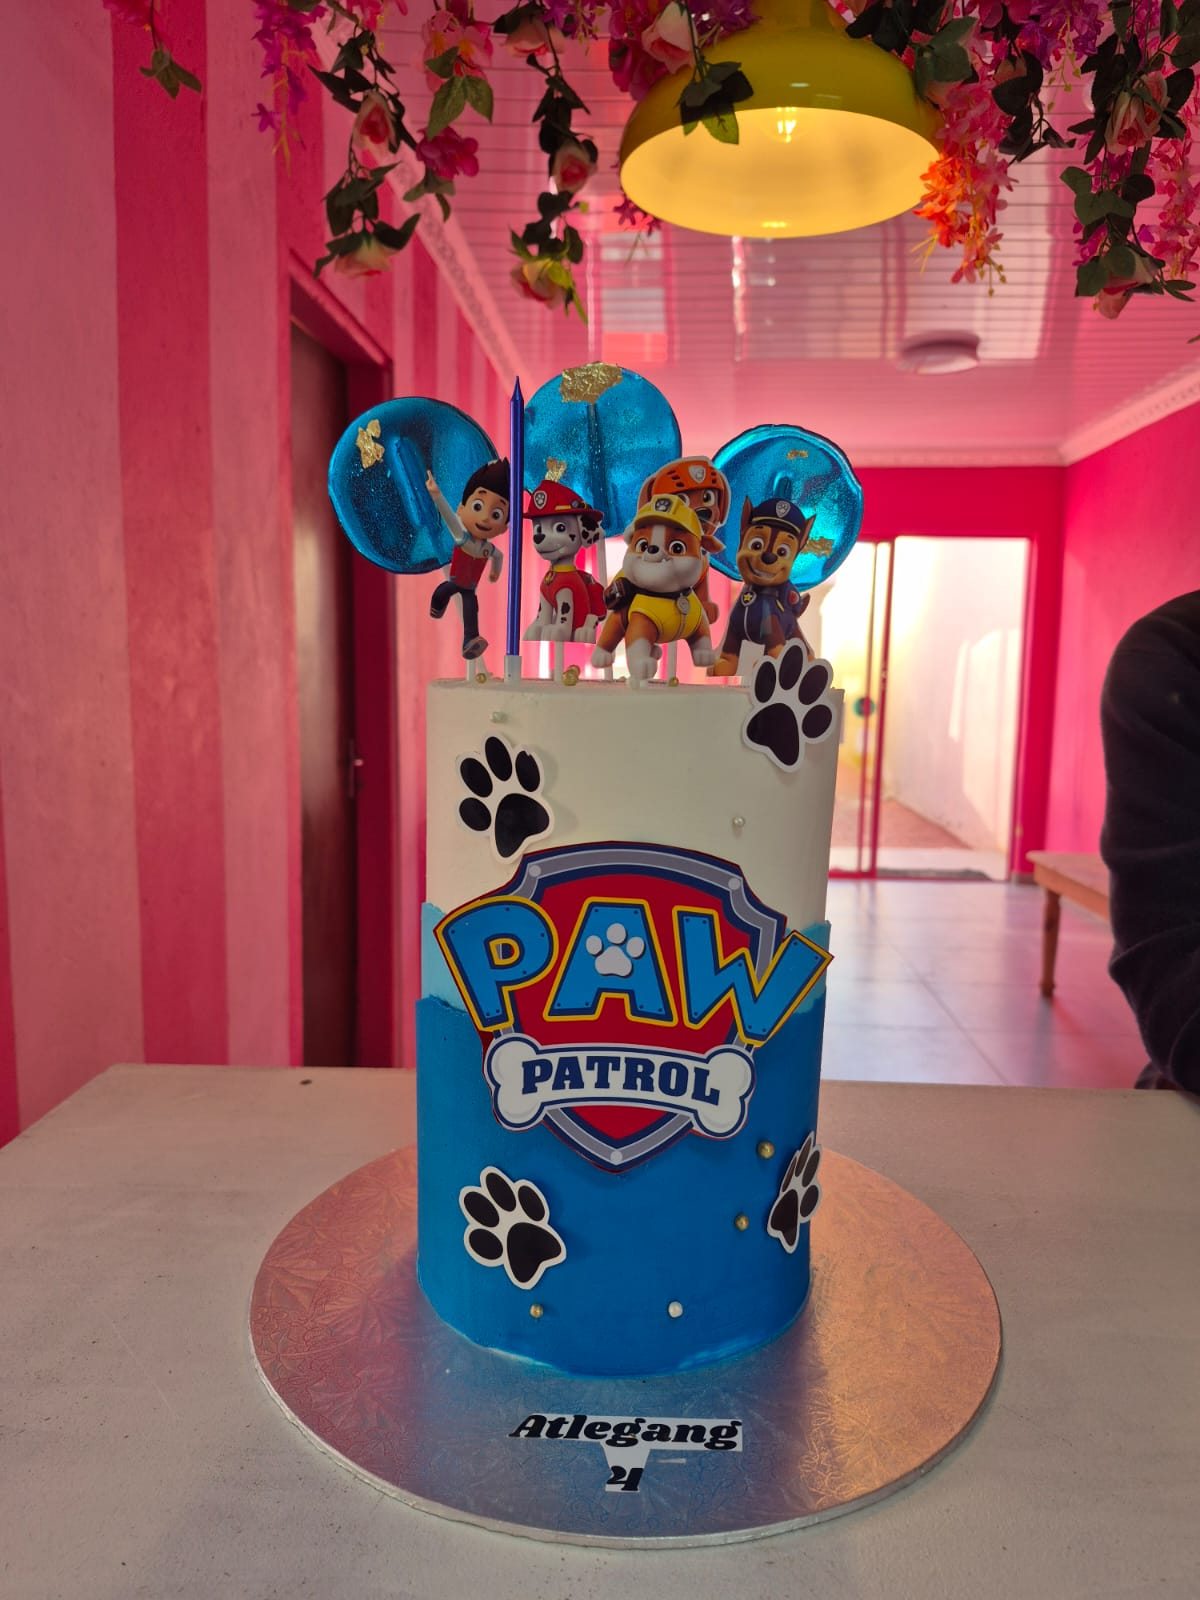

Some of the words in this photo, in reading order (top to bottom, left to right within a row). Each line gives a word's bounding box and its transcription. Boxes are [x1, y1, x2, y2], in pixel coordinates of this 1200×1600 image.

[434, 896, 833, 1047] PAW
[521, 1056, 720, 1106] PATROL
[508, 1414, 743, 1450] Atlegang
[606, 1465, 644, 1491] 4
